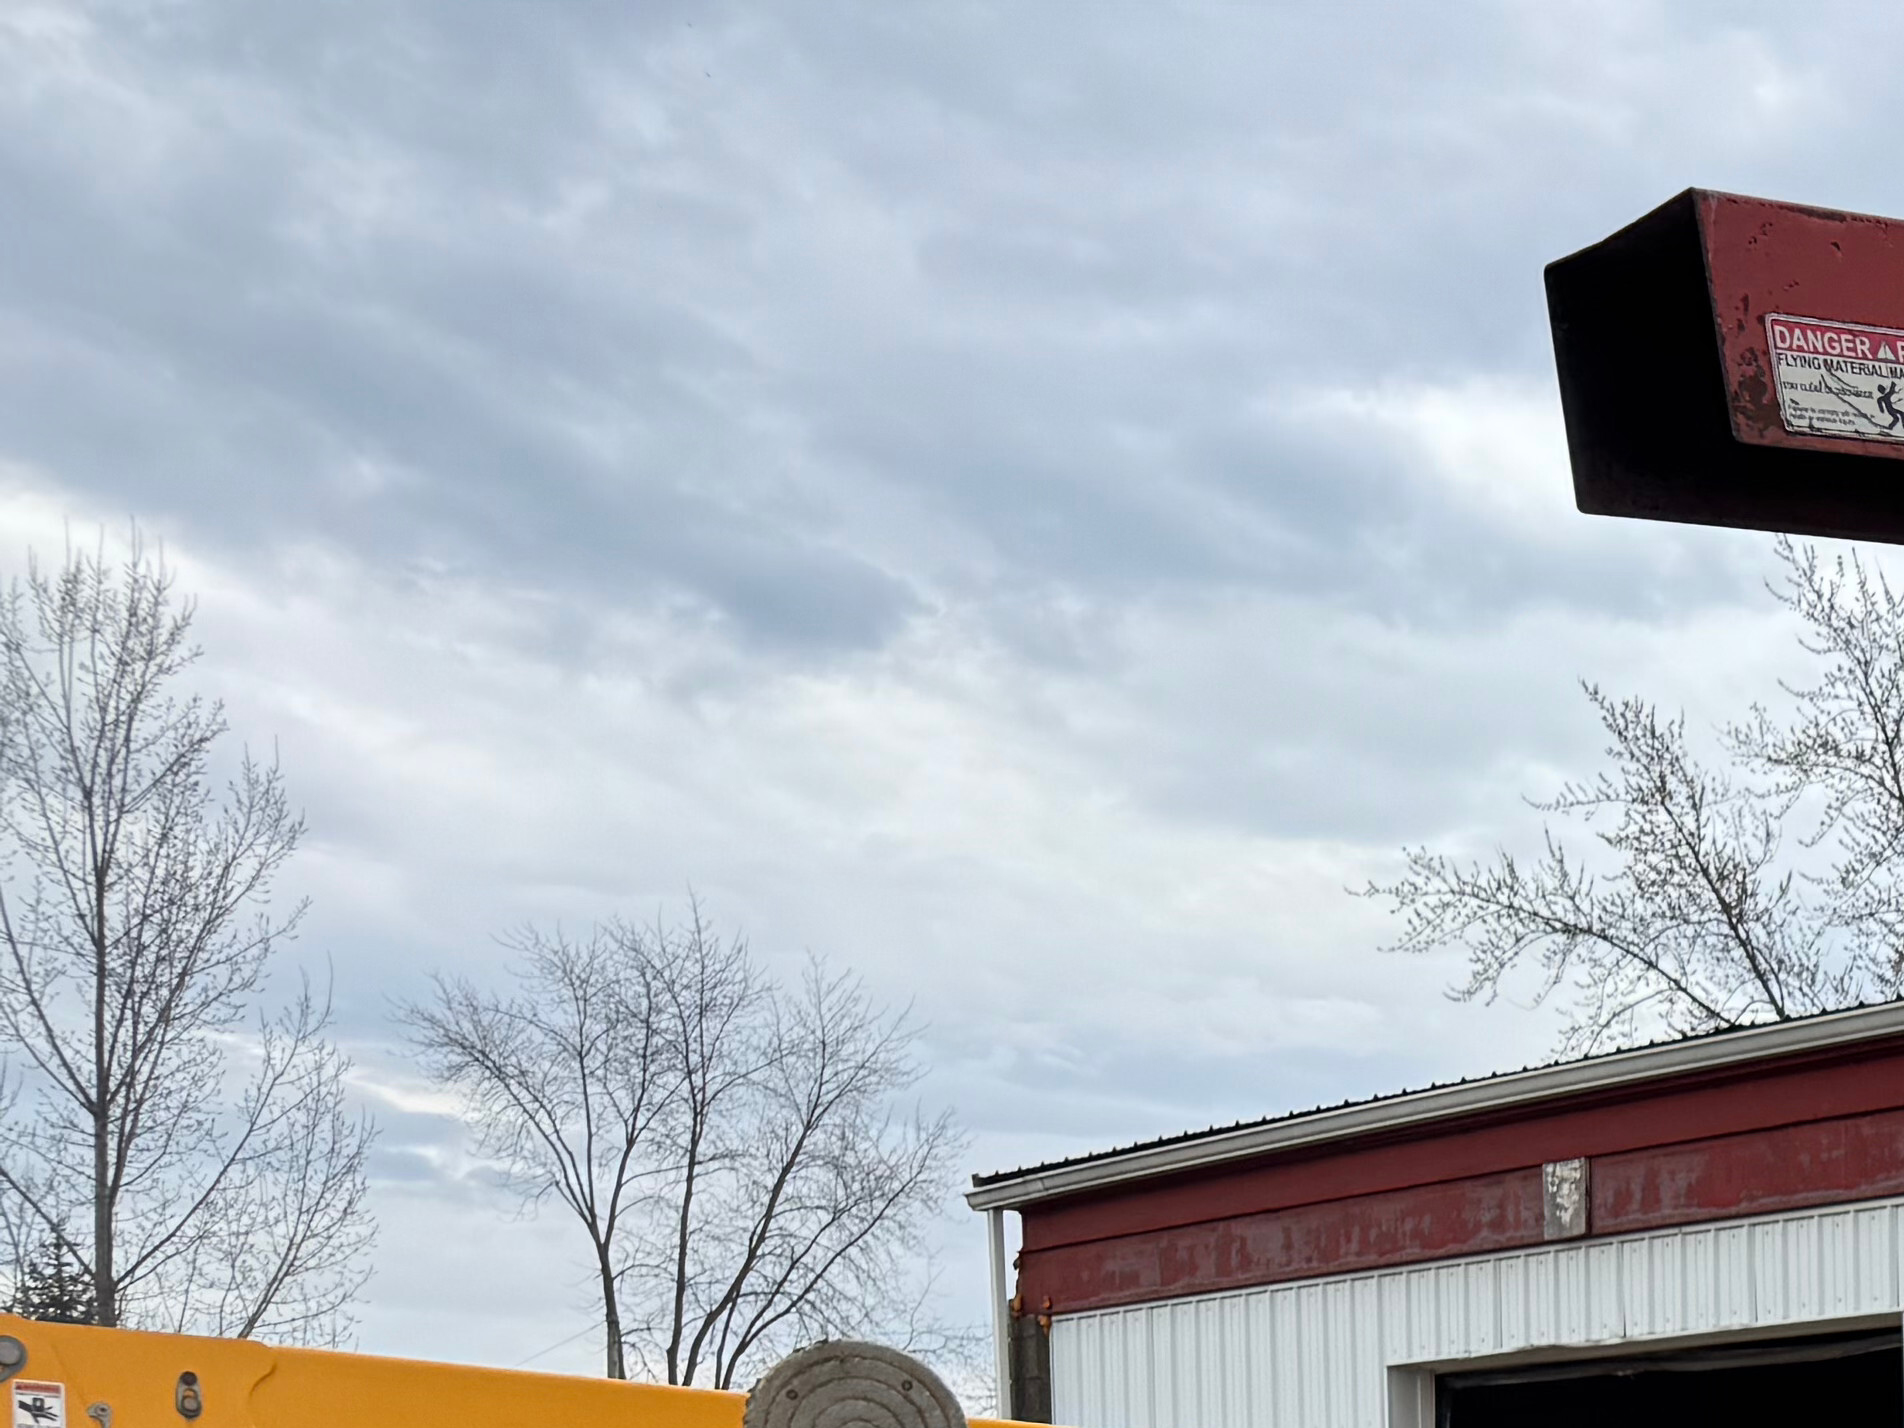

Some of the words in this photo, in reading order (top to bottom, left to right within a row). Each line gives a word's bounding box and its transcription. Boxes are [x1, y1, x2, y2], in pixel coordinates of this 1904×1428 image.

[1773, 325, 1873, 359] DANGER
[1777, 352, 1822, 371] FLYING
[1822, 357, 1889, 379] MATERIAL
